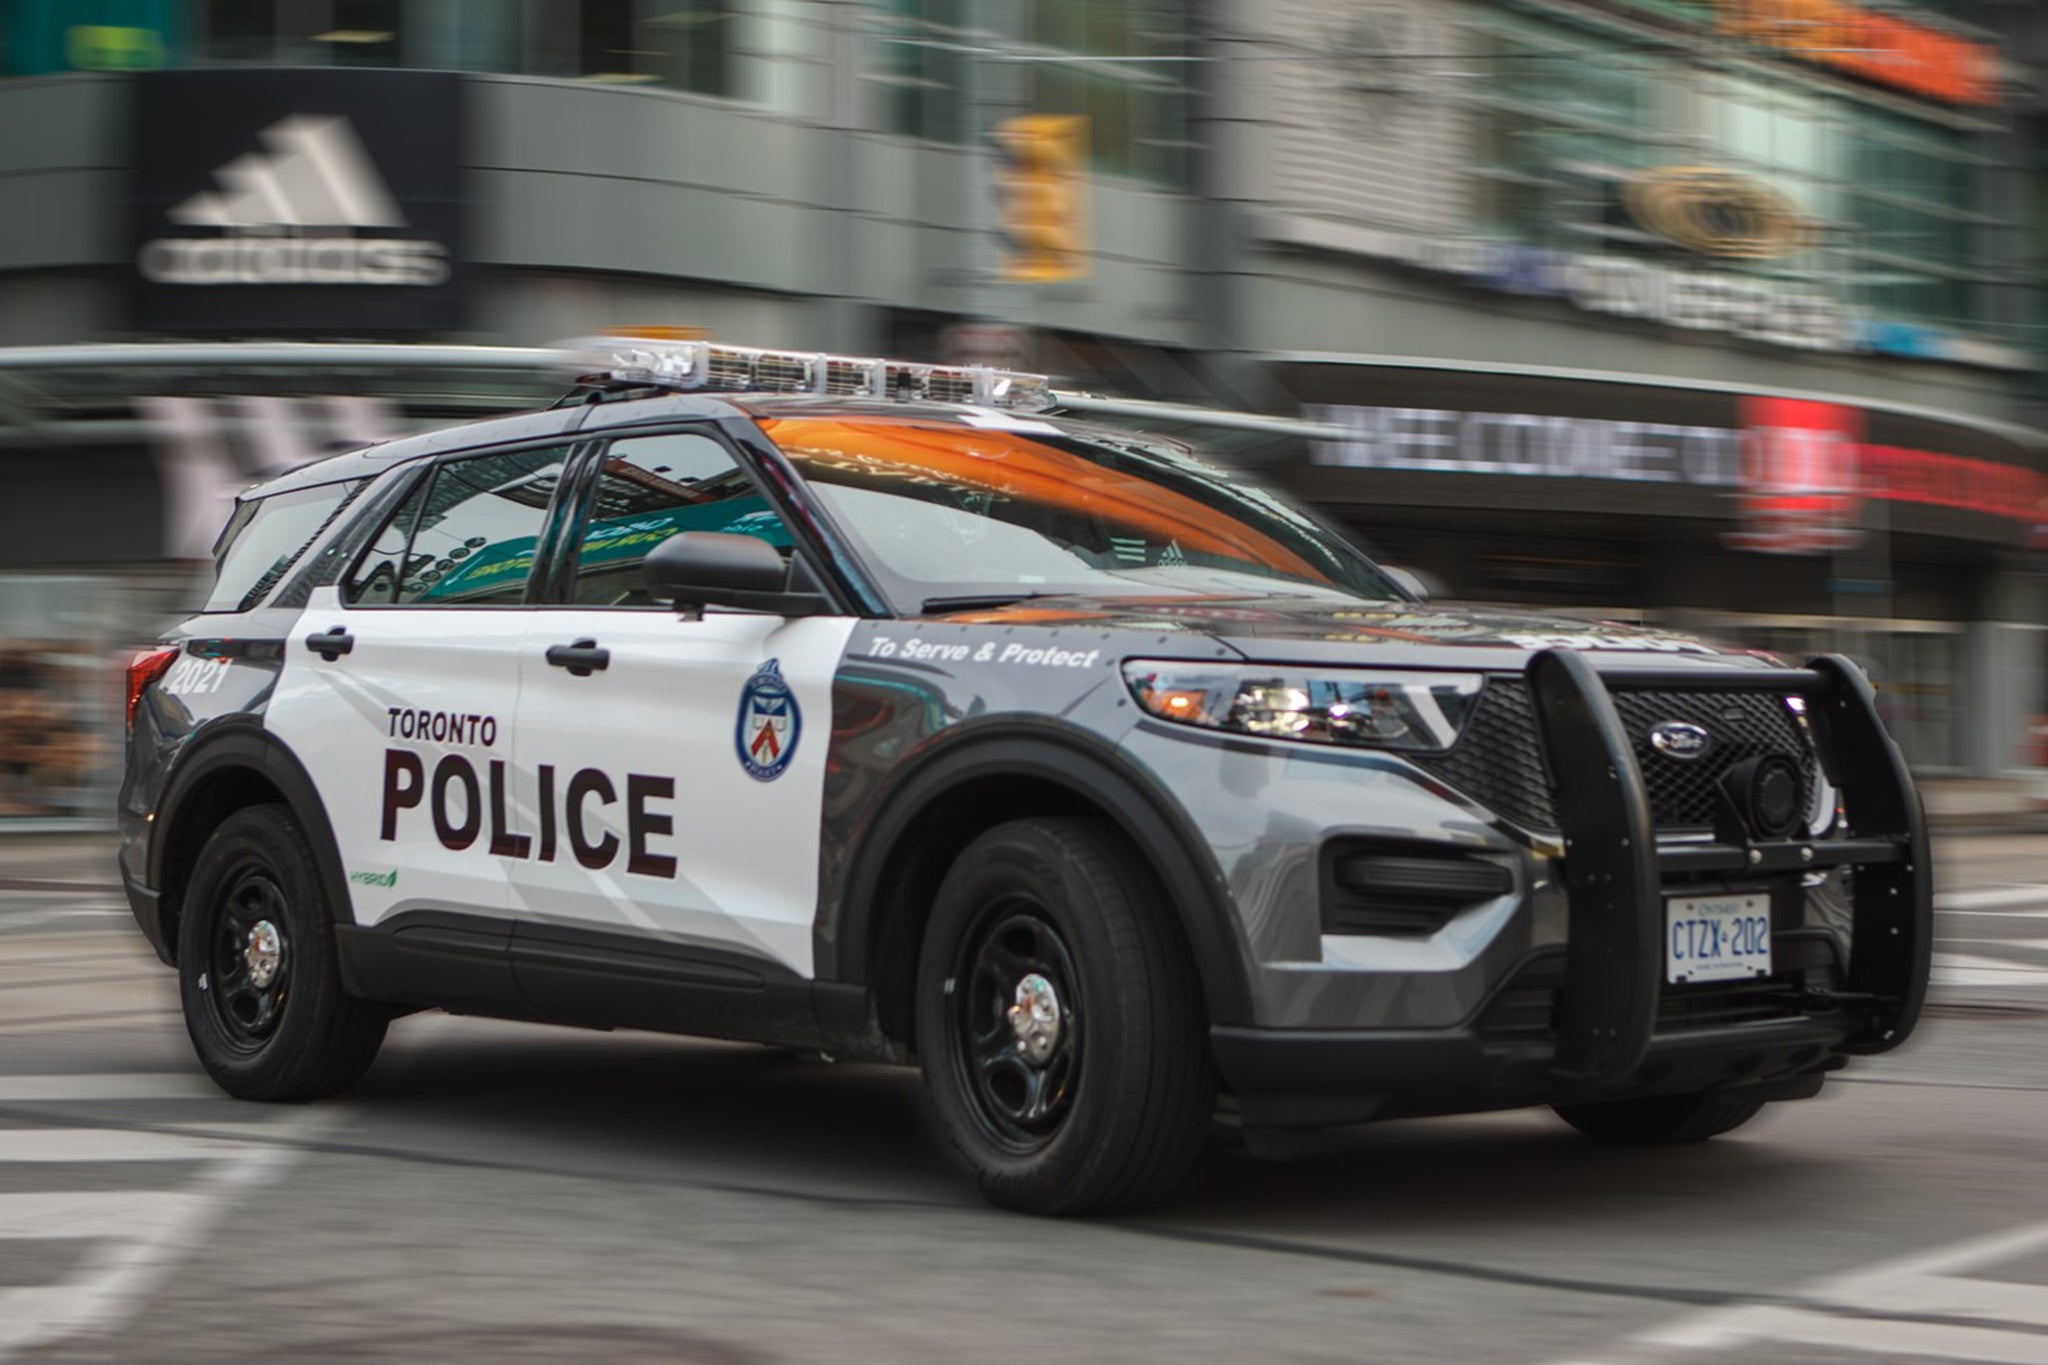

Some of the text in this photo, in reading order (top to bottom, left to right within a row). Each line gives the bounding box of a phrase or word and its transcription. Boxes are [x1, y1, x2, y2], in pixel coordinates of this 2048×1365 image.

[138, 238, 451, 286] adidas
[868, 636, 1101, 668] To Serve & Protect
[166, 658, 234, 695] 2021
[388, 707, 497, 747] TORONTO
[380, 748, 678, 880] POLICE
